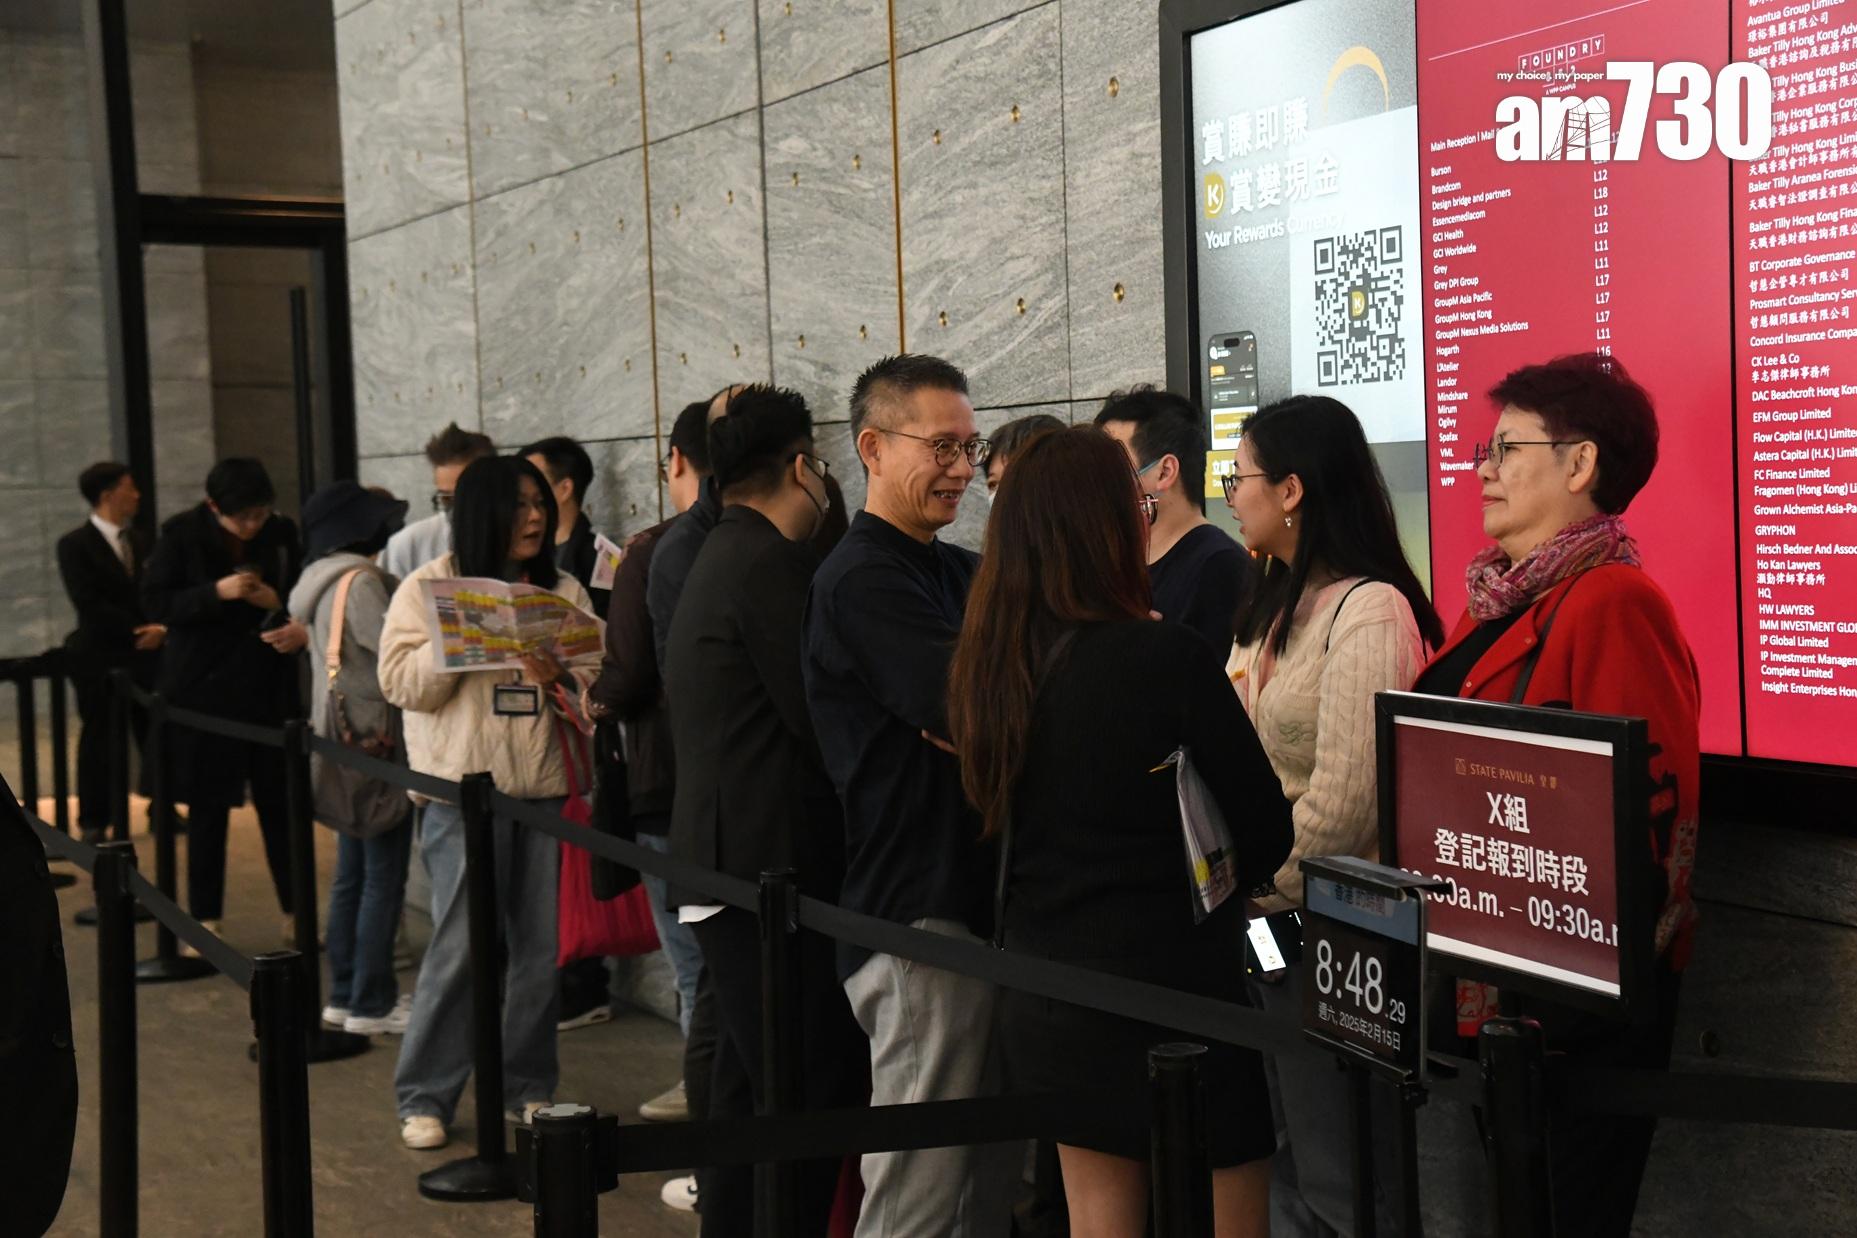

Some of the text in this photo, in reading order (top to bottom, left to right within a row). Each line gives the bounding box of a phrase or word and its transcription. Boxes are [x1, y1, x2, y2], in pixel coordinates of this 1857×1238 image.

[1748, 11, 1781, 27] Avantua
[1783, 3, 1810, 17] Group
[1748, 29, 1839, 58] Baker Tilly Hong Kong
[1521, 40, 1601, 69] FOUNDRY
[1772, 66, 1838, 87] Tilly Hong Kong
[1772, 101, 1837, 122] Tilly Hong Kong
[1431, 142, 1446, 152] Main
[1446, 136, 1476, 149] Reception
[1481, 132, 1495, 142] Mail
[1773, 145, 1790, 158] Tilly
[1791, 143, 1814, 155] Hong
[1816, 137, 1838, 150] Kong
[1431, 165, 1451, 177] Burson
[1594, 169, 1608, 182] L12
[1230, 150, 1339, 215] 賞變現金
[1432, 181, 1461, 195] Brandcom
[1748, 173, 1822, 193] Baker Tilly Aranea
[1432, 188, 1511, 211] Design bridge and partners
[1594, 187, 1608, 200] L18
[1594, 204, 1608, 217] L12
[1432, 210, 1486, 227] Essencemediacom
[1749, 211, 1838, 233] Baker Tilly Hong Kong
[1205, 230, 1232, 250] Your
[1234, 217, 1285, 245] Rewards
[1595, 222, 1609, 234] L12
[1433, 229, 1464, 243] GCI Health
[1433, 243, 1477, 259] GCI Worldwide
[1595, 240, 1609, 252] L11
[1595, 257, 1609, 269] L11
[1749, 250, 1856, 272] BT Corporate Governance
[1433, 264, 1448, 276] Grey
[1434, 280, 1448, 291] Grey
[1460, 276, 1479, 287] Group
[1595, 274, 1610, 287] L17
[1434, 291, 1493, 308] GroupM Asia Pacific
[1596, 292, 1610, 304] L17
[1750, 291, 1840, 310] Prosmart Consultancy
[1435, 309, 1493, 325] GroupM Hong Kong
[1596, 311, 1610, 323] L17
[1435, 321, 1529, 341] GroupM Nexus Media Solutions
[1597, 328, 1611, 340] L11
[1750, 331, 1826, 347] Concord Insurance
[1436, 344, 1460, 357] Hogarth
[1751, 353, 1800, 367] CK Lee & Co
[1437, 377, 1457, 388] Landor
[1437, 391, 1468, 402] Mindshare
[1752, 386, 1840, 402] DAC Beachcroft Hong
[1438, 405, 1458, 415] Mirum
[1753, 407, 1832, 423] EFM Group Limited
[1438, 418, 1457, 429] Ogilvy
[1753, 428, 1828, 443] Flow Capital (H.K.)
[1440, 448, 1454, 458] VML
[1754, 447, 1835, 462] Astera Capital (H.K.)
[1440, 460, 1475, 472] Wavemaker
[1754, 467, 1830, 480] FC Finance Limited
[1441, 477, 1455, 487] WPP
[1754, 483, 1848, 498] Fragomen (Hong Kong)
[1754, 505, 1781, 515] Grown
[1783, 504, 1824, 514] Alchemist
[1755, 525, 1796, 536] GRYPHON
[1756, 544, 1832, 554] Hirsch Bedner And
[1757, 560, 1821, 572] Ho Kan Lawyers
[1758, 588, 1772, 599] HQ
[1759, 604, 1815, 615] HW LAWYERS
[1760, 620, 1835, 632] IMM INVESTMENT
[1760, 634, 1829, 648] IP Global Limited
[1761, 651, 1816, 664] IP Investment
[1761, 664, 1833, 679] Complete Limited
[1762, 681, 1837, 696] Insight Enterprises
[1470, 763, 1497, 778] STATE
[1499, 769, 1535, 785] PAVILIA
[1486, 791, 1530, 834] X組
[1434, 828, 1590, 896] 登記報到時段
[1339, 1011, 1401, 1051] 2025年2月15日
